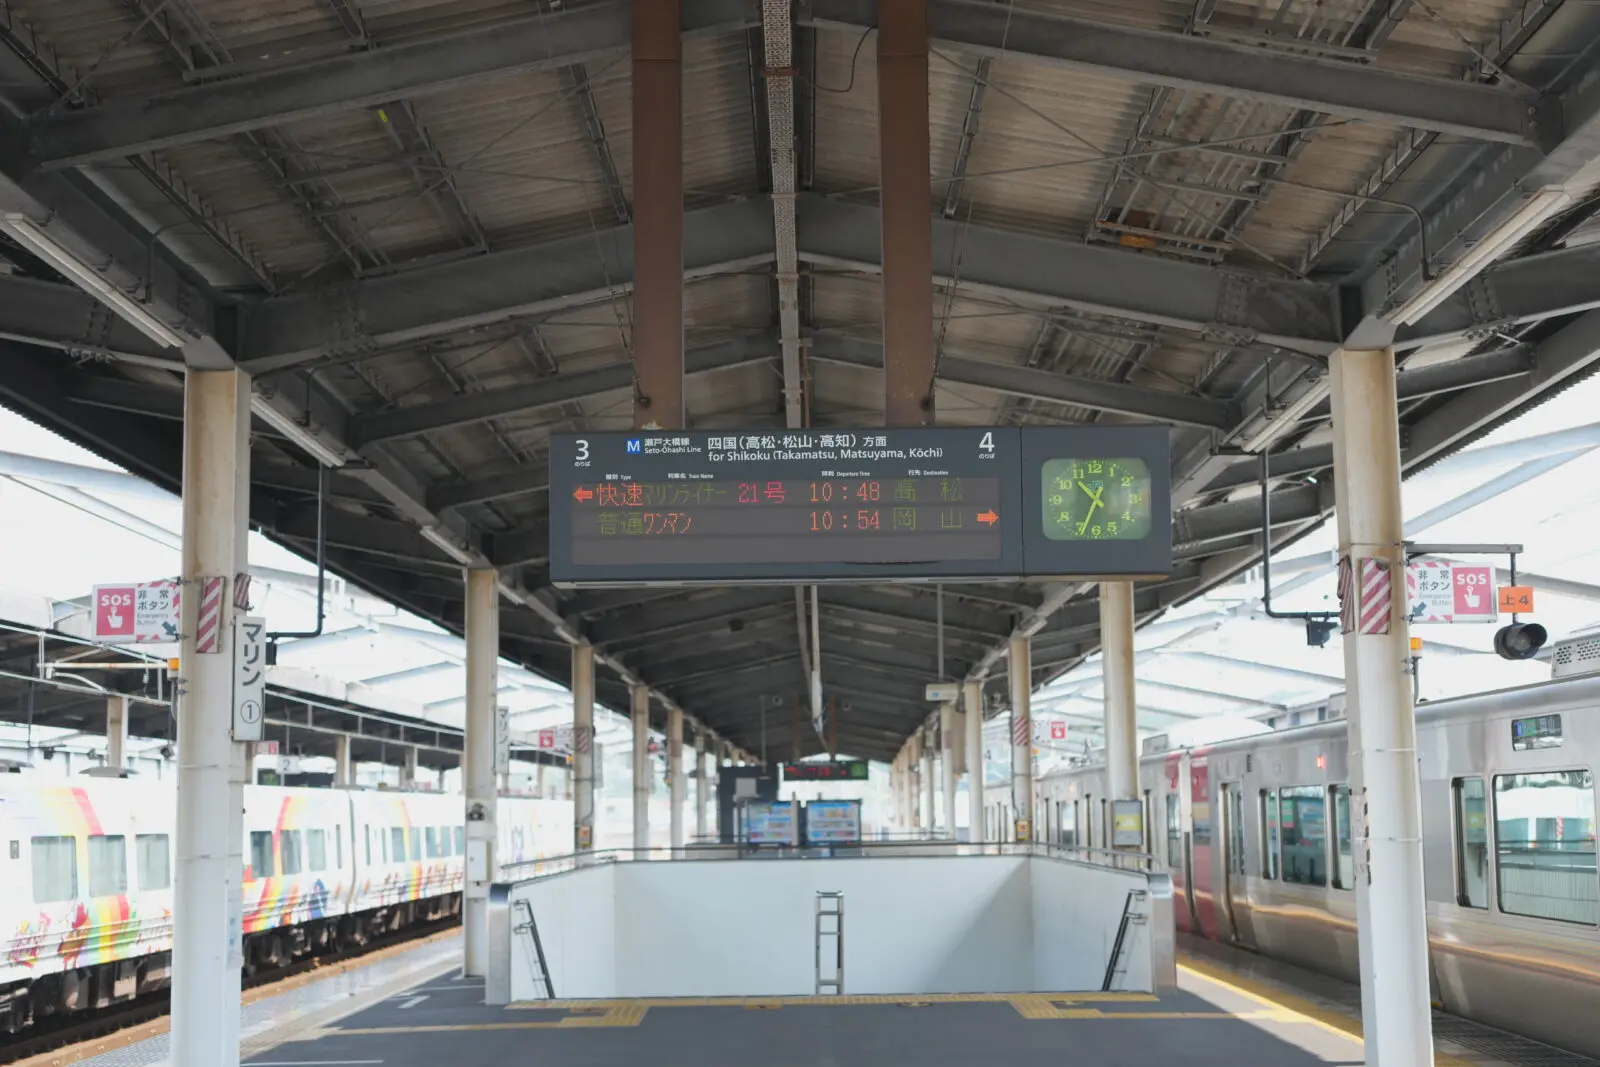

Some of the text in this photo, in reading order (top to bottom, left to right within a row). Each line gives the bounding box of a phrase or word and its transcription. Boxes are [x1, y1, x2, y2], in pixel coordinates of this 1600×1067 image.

[627, 440, 641, 453] M
[644, 438, 690, 446] 瀬戸大橋線
[863, 436, 887, 447] 方面
[979, 432, 995, 452] 4
[575, 440, 589, 460] 3
[708, 451, 724, 461] for
[727, 451, 770, 461] Shikoku
[773, 450, 838, 461] (Takamatsu,
[840, 449, 907, 461] Matsuyama,
[1072, 468, 1085, 479] 11
[1088, 463, 1102, 474] 12
[1109, 467, 1115, 477] 1
[1058, 480, 1072, 490] 10
[1121, 476, 1131, 487] 2
[597, 482, 643, 506] 快速
[644, 483, 727, 504] マリンライナー
[809, 481, 880, 502] 10:48
[1053, 495, 1062, 505] 9
[1060, 511, 1070, 521] 8
[1121, 511, 1131, 521] 4
[597, 512, 643, 535] 普通
[643, 512, 692, 534] ワンマン
[809, 510, 880, 530] 10:54
[1107, 522, 1117, 532] 5
[1091, 525, 1101, 536] 6
[1418, 570, 1449, 580] 非常
[1456, 573, 1487, 585] SOS
[1420, 581, 1450, 591] ボタン
[138, 589, 169, 599] 非常
[101, 594, 131, 606] SOS
[137, 601, 169, 610] ボタン
[242, 623, 262, 686] マリン
